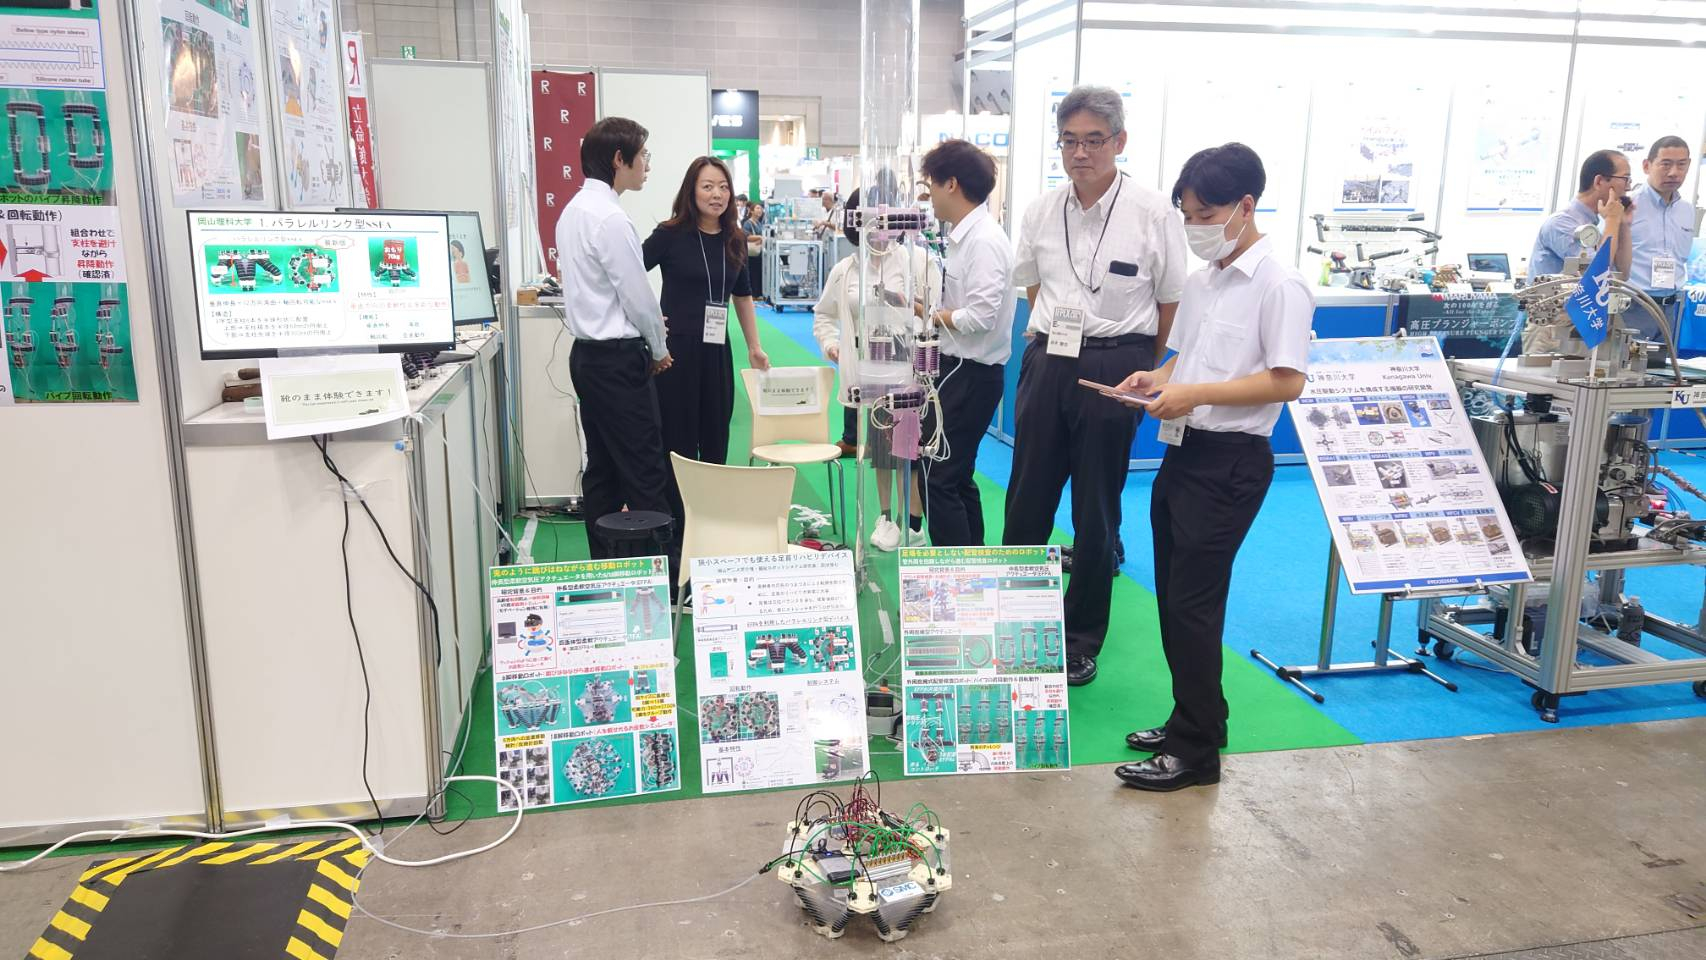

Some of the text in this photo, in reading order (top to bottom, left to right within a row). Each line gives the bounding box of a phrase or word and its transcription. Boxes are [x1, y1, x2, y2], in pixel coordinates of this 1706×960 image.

[541, 80, 550, 93] R
[578, 81, 587, 95] R
[560, 109, 569, 122] R
[544, 137, 552, 150] R
[563, 166, 572, 178] R
[546, 193, 555, 206] R
[82, 250, 107, 258] ながら
[549, 248, 557, 259] R
[77, 259, 114, 268] 昇降動作
[1674, 390, 1691, 405] KU
